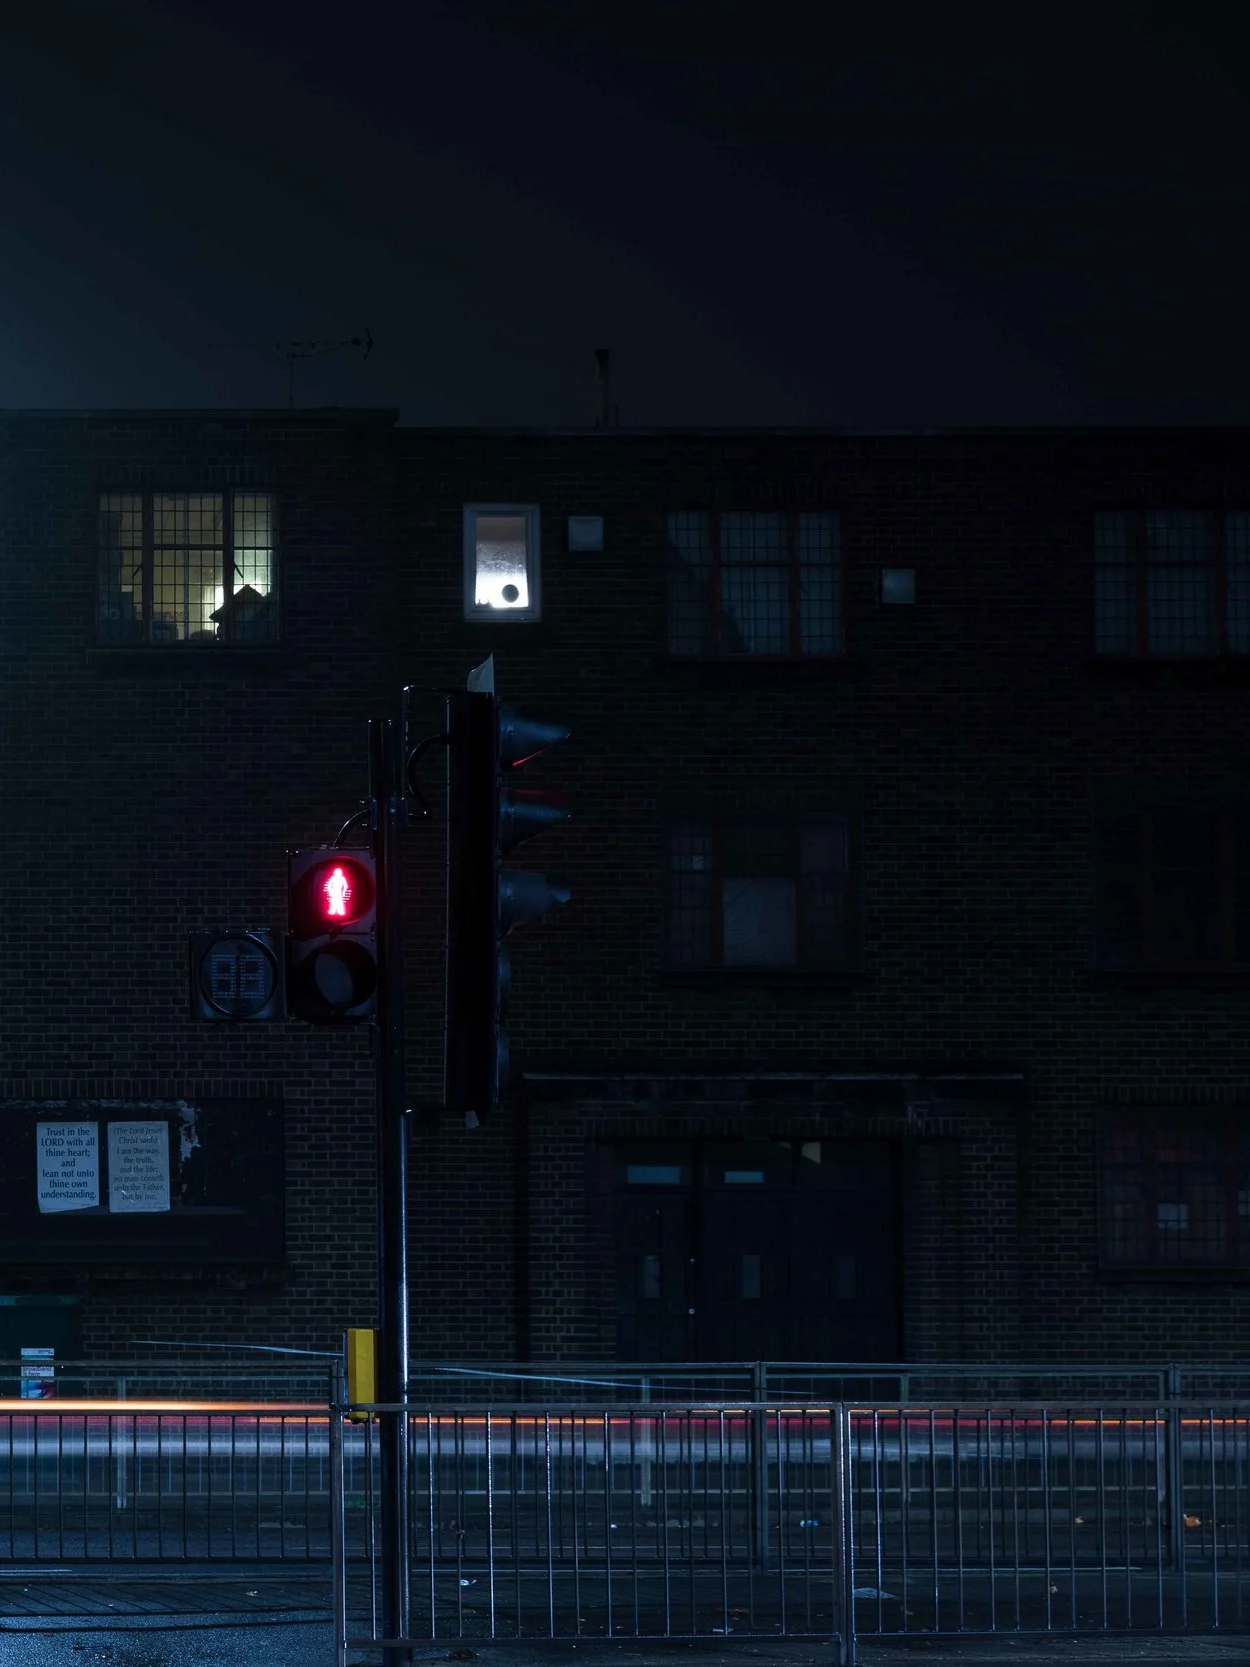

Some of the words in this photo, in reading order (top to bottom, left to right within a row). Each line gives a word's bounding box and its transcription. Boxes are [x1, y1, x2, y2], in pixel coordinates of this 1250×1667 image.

[46, 1127, 65, 1136] Trust
[67, 1127, 75, 1136] in
[77, 1127, 91, 1136] the
[41, 1137, 64, 1146] LORD
[66, 1137, 84, 1146] with
[85, 1137, 95, 1146] all
[45, 1148, 65, 1157] thine
[67, 1148, 91, 1158] heart;
[61, 1158, 76, 1167] and
[42, 1169, 59, 1178] lean
[61, 1170, 74, 1178] not
[76, 1169, 95, 1178] unto
[49, 1179, 69, 1188] thine
[41, 1190, 97, 1200] understanding.
